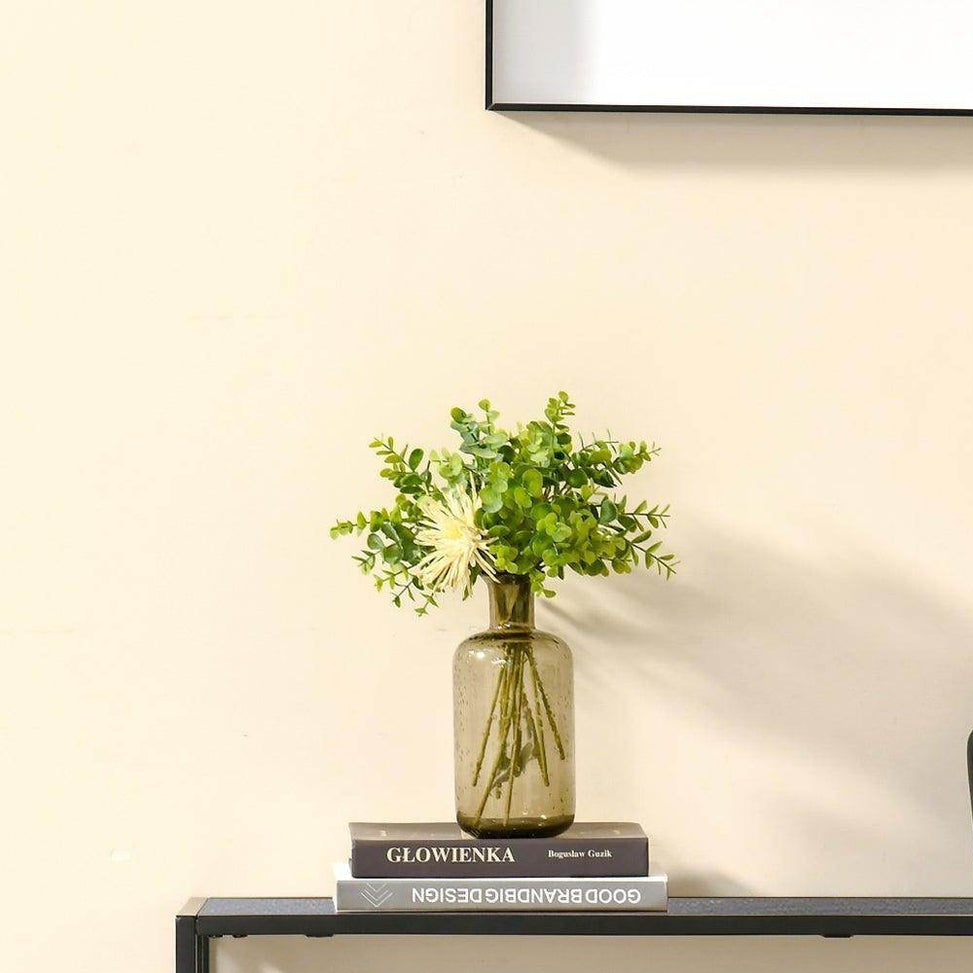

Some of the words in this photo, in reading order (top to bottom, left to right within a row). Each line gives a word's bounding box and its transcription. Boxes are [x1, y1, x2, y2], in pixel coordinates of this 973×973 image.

[387, 848, 514, 862] GŁOWIENKA
[587, 849, 613, 858] Guzik
[412, 888, 482, 904] DESIGN
[586, 888, 642, 904] GOOD
